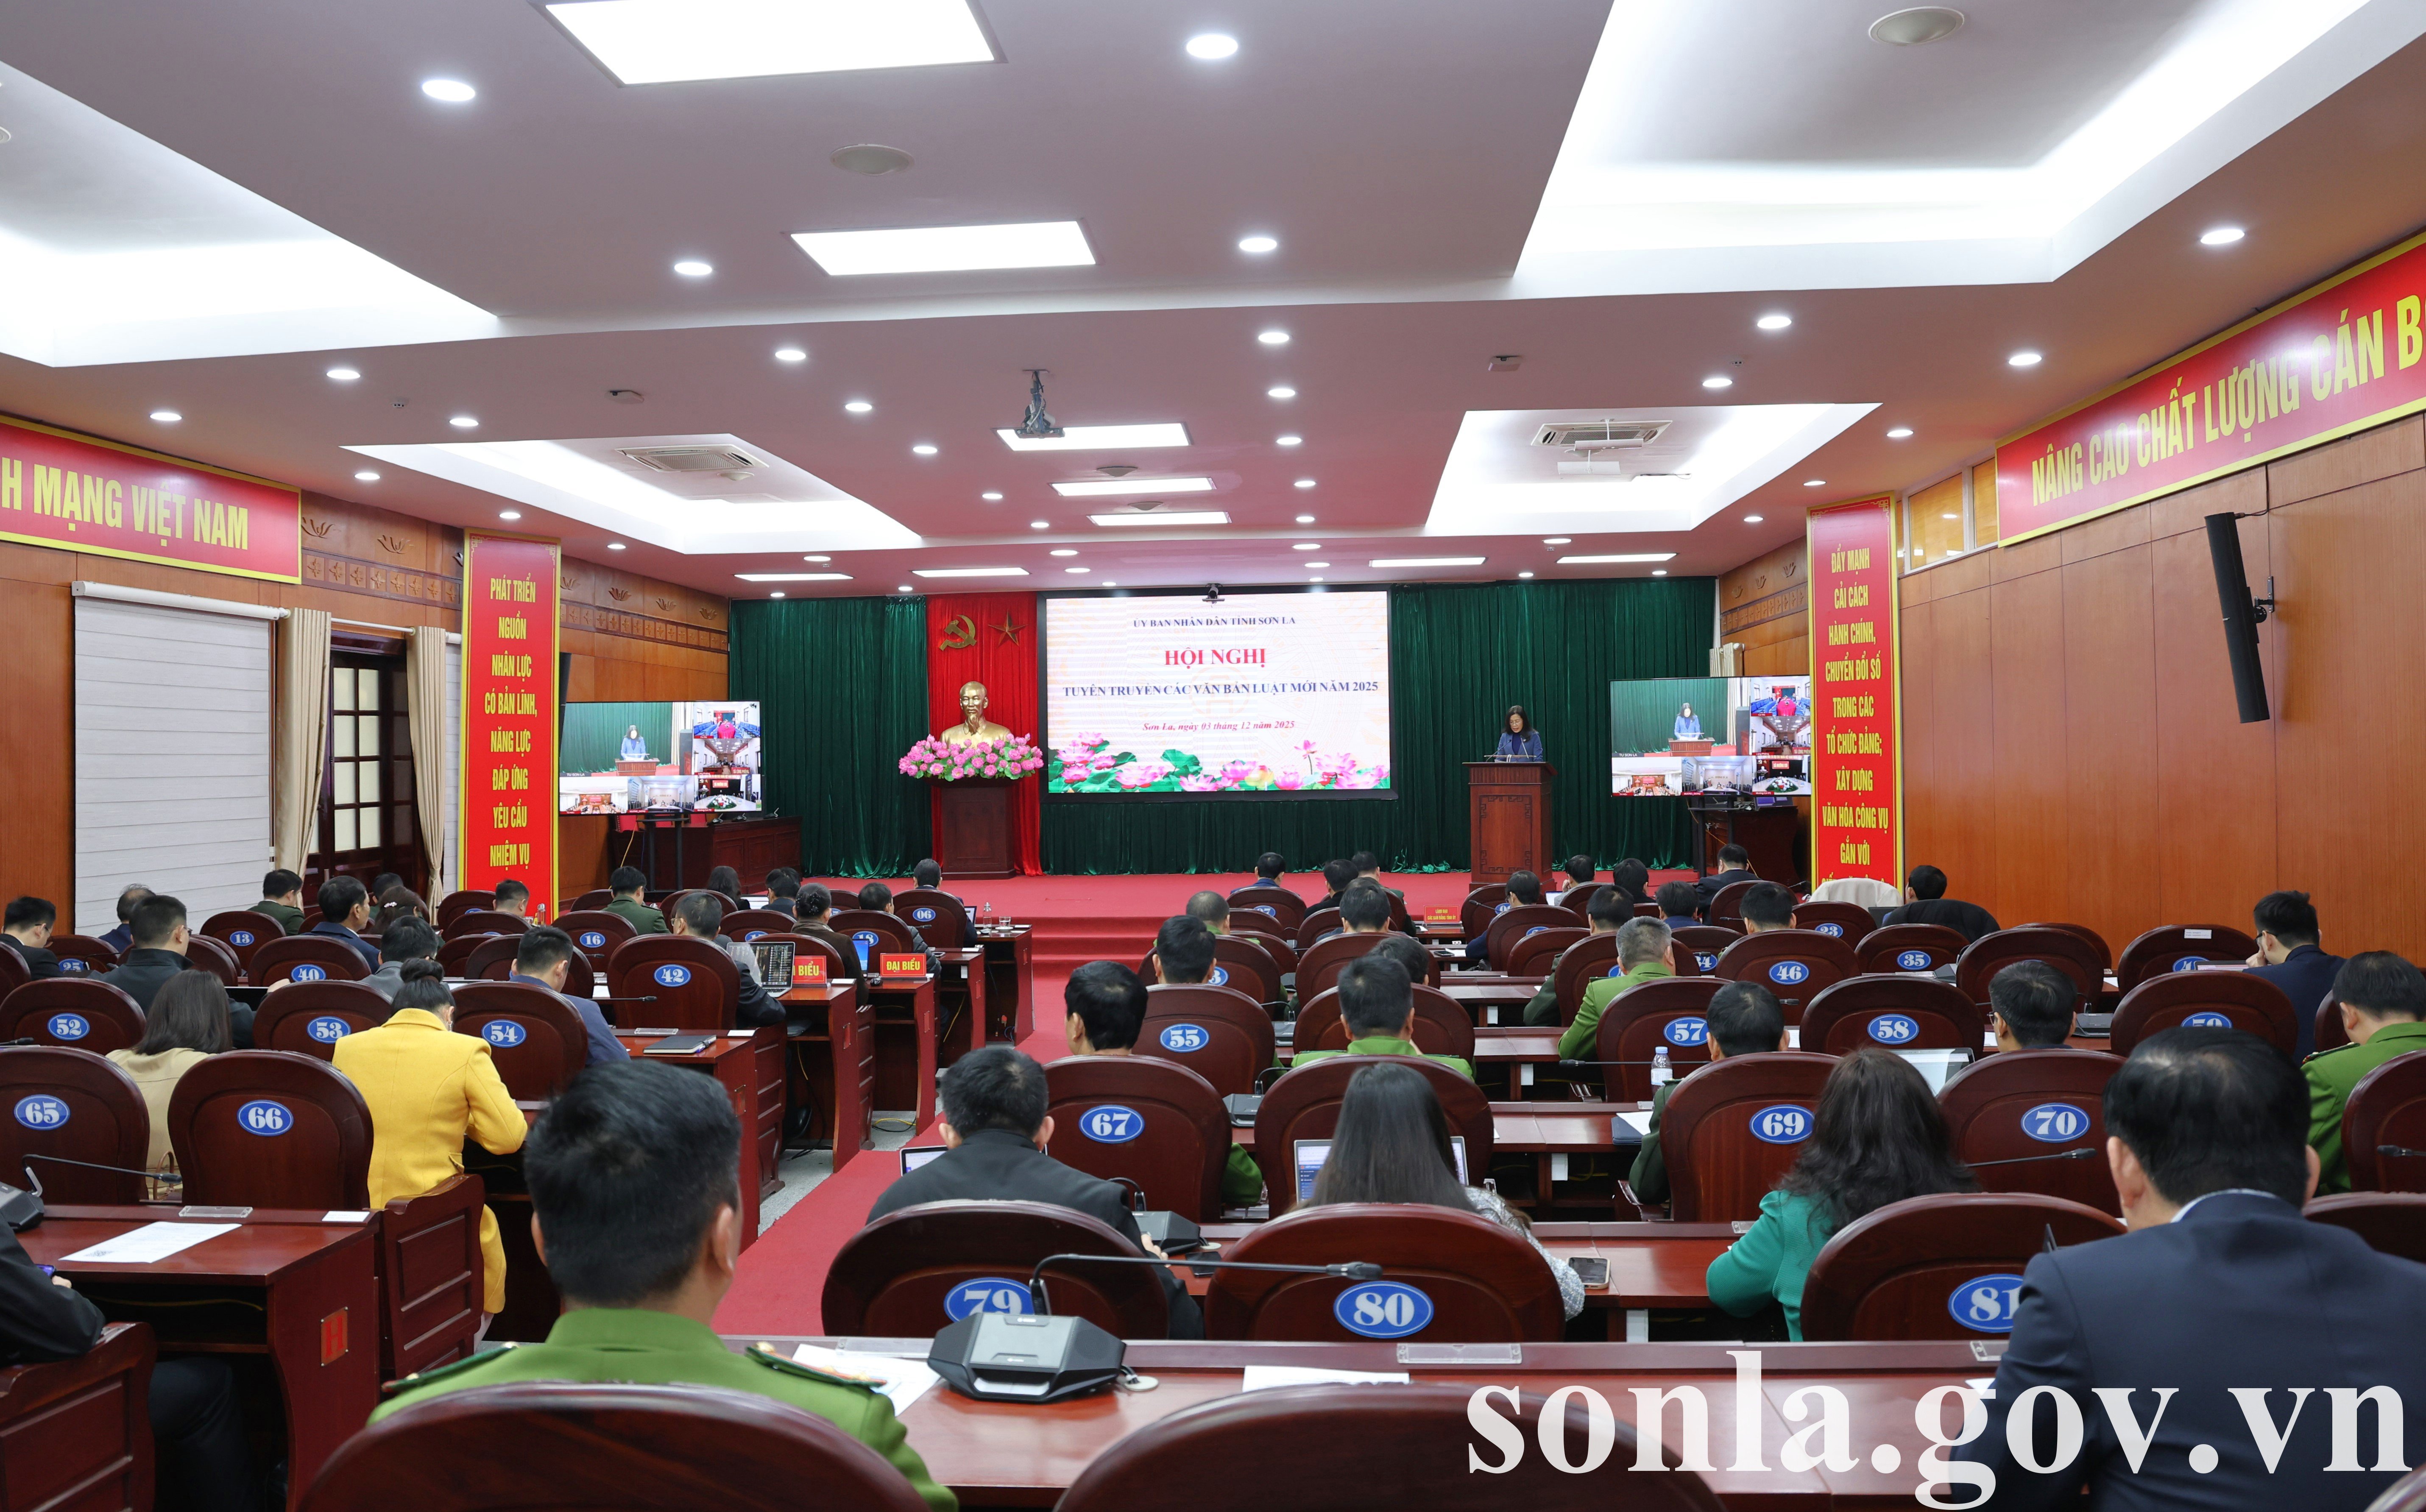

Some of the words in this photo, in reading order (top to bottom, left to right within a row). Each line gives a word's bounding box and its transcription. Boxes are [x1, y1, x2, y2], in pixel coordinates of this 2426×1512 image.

[2032, 447, 2083, 507] NÂNG
[2089, 422, 2129, 485] CAO
[2136, 377, 2196, 468] CHẤT
[2205, 352, 2300, 443] LƯỢNG
[2311, 308, 2385, 402] CÁN
[2397, 295, 2426, 371] B
[34, 464, 122, 531] MẠNG
[131, 482, 186, 547] VIỆT
[194, 498, 248, 550] NAM
[1831, 543, 1846, 573] ĐẨY
[1847, 547, 1870, 575] MẠNH
[490, 575, 511, 601] PHÁT
[513, 572, 535, 603] TRIỂN
[1834, 581, 1846, 609] CẢI
[1849, 582, 1868, 608] CÁCH
[498, 611, 527, 639] NGUỒN
[1174, 616, 1203, 627] NHÂN
[1206, 616, 1227, 626] DÂN
[1258, 616, 1279, 625] SƠN
[1829, 620, 1849, 646] HÀNH
[1850, 618, 1876, 645] CHÍNH,
[492, 650, 515, 677] NHÂN
[517, 653, 532, 682] LỰC
[1164, 647, 1204, 669] HỘI
[1211, 648, 1266, 668] NGHỊ
[1826, 652, 1854, 682] CHUYỂN
[1856, 650, 1868, 681] ĐỔI
[1871, 650, 1881, 680] SỐ
[1063, 684, 1106, 696] TUYÊN
[1163, 682, 1191, 695] CÁC
[1193, 683, 1220, 695] VĂN
[1224, 681, 1250, 694] BẢN
[1290, 680, 1316, 692] MỚI
[1319, 680, 1350, 692] NĂM
[1352, 681, 1378, 691] 2025
[484, 688, 496, 715] CÓ
[498, 686, 515, 714] BẢN
[516, 689, 537, 717] LĨNH,
[1832, 696, 1857, 718] TRONG
[1859, 692, 1874, 717] CÁC
[1143, 723, 1159, 731] Sơn
[1162, 723, 1175, 731] La,
[1178, 723, 1199, 732] ngày
[1214, 721, 1238, 731] tháng
[491, 726, 513, 752] NĂNG
[516, 729, 531, 757] LỰC
[1826, 725, 1835, 755] TỔ
[1838, 729, 1857, 754] CHỨC
[1859, 726, 1882, 756] ĐẢNG;
[492, 764, 509, 790] ĐÁP
[511, 764, 528, 790] ỨNG
[1836, 766, 1850, 790] XÂY
[1852, 768, 1873, 795] DỰNG
[493, 802, 509, 828] YÊU
[510, 799, 527, 828] CẦU
[1822, 802, 1837, 826] VĂN
[1839, 802, 1854, 827] HÓA
[1856, 803, 1876, 829] CÔNG
[1878, 808, 1888, 834] VỤ
[490, 840, 517, 870] NHIỆM
[519, 843, 530, 869] VỤ
[1840, 835, 1856, 865] GẮN
[1857, 840, 1870, 865] VỚI
[917, 911, 931, 919] 06
[235, 933, 250, 944] 13
[584, 935, 601, 945] 16
[1821, 926, 1839, 937] 23
[798, 961, 819, 976] BIỂU
[887, 961, 900, 972] ĐẠI
[903, 957, 920, 971] BIỂU
[1905, 955, 1924, 966] 35
[298, 968, 319, 980] 40
[661, 969, 684, 982] 42
[1777, 967, 1801, 980] 46
[56, 1019, 81, 1035] 52
[316, 1022, 343, 1039] 53
[490, 1025, 518, 1043] 54
[1169, 1030, 1200, 1048] 55
[1674, 1024, 1704, 1041] 57
[1878, 1021, 1909, 1038] 58
[25, 1102, 59, 1123] 65
[248, 1107, 283, 1129] 66
[1091, 1113, 1130, 1136] 67
[2035, 1110, 2077, 1136] 70
[1762, 1114, 1806, 1136] 69
[963, 1290, 1022, 1315] 79
[1354, 1293, 1415, 1326] 80
[1970, 1288, 2019, 1322] 81
[323, 1315, 345, 1358] H
